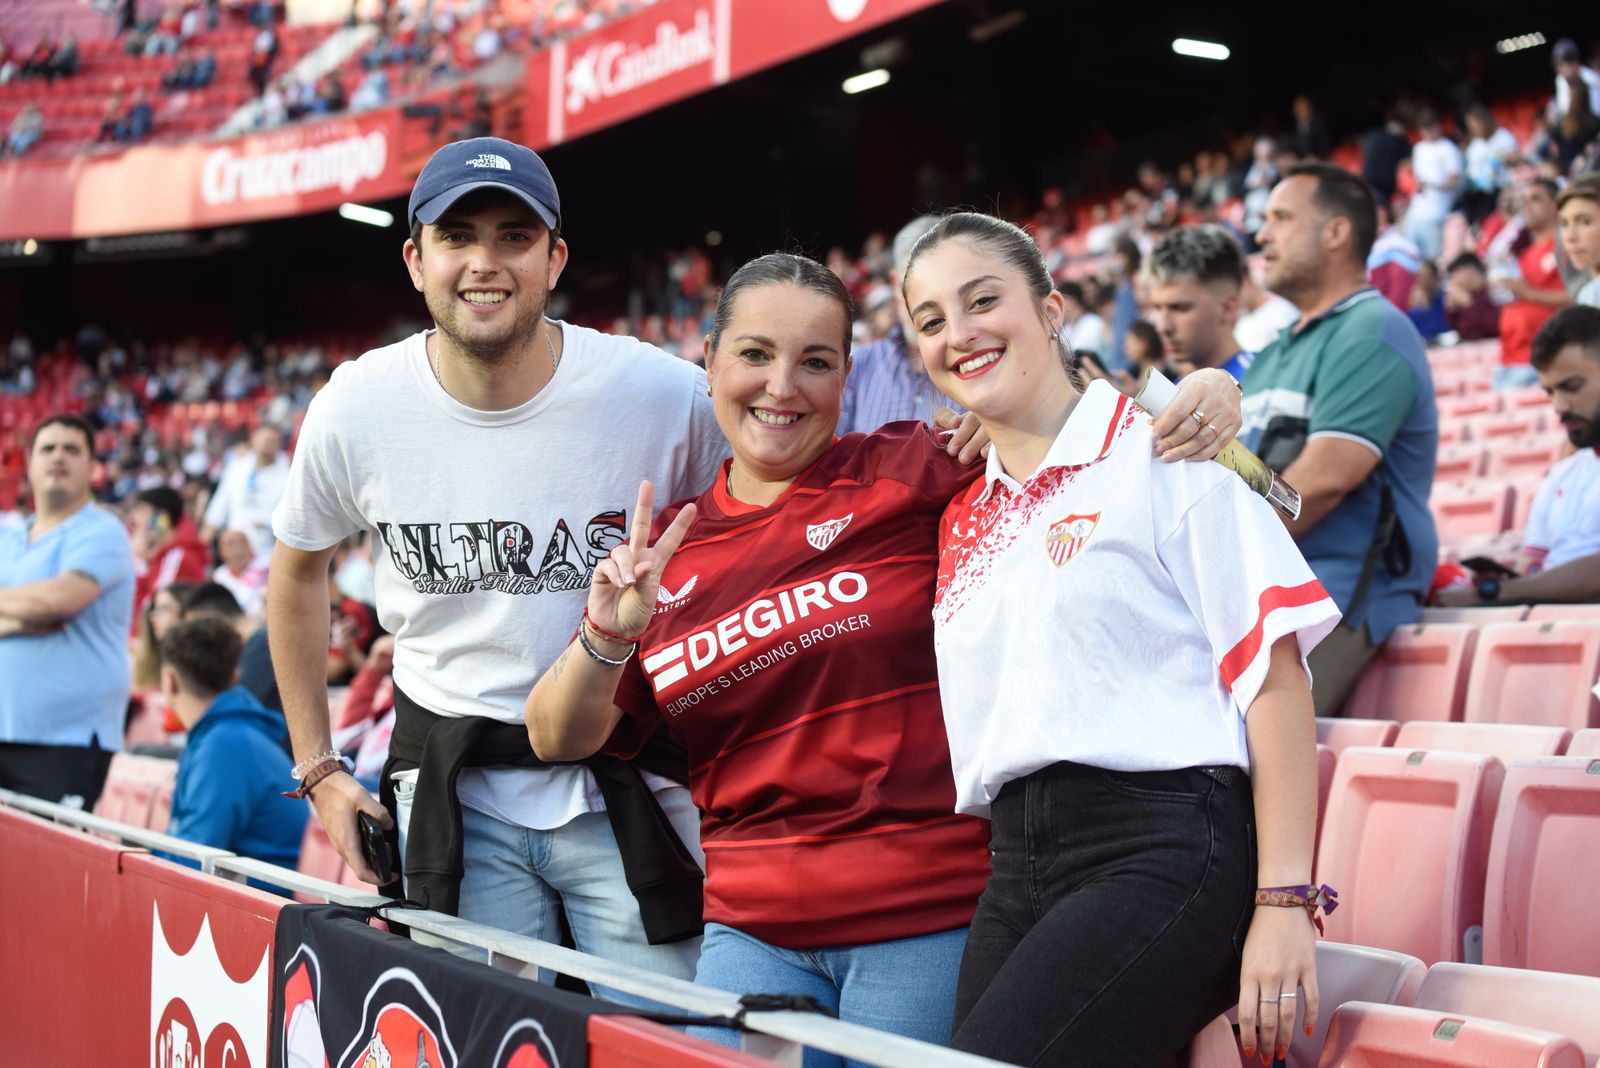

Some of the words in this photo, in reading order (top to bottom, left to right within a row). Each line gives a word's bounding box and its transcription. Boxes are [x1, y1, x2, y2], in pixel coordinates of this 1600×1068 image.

[466, 158, 496, 166] NORTH
[377, 509, 627, 582] ULTRAS
[413, 573, 475, 594] Sevilla
[547, 568, 593, 592] Club
[687, 571, 868, 672] DEGIRO
[730, 641, 798, 682] LEADING
[799, 614, 871, 649] BROKER
